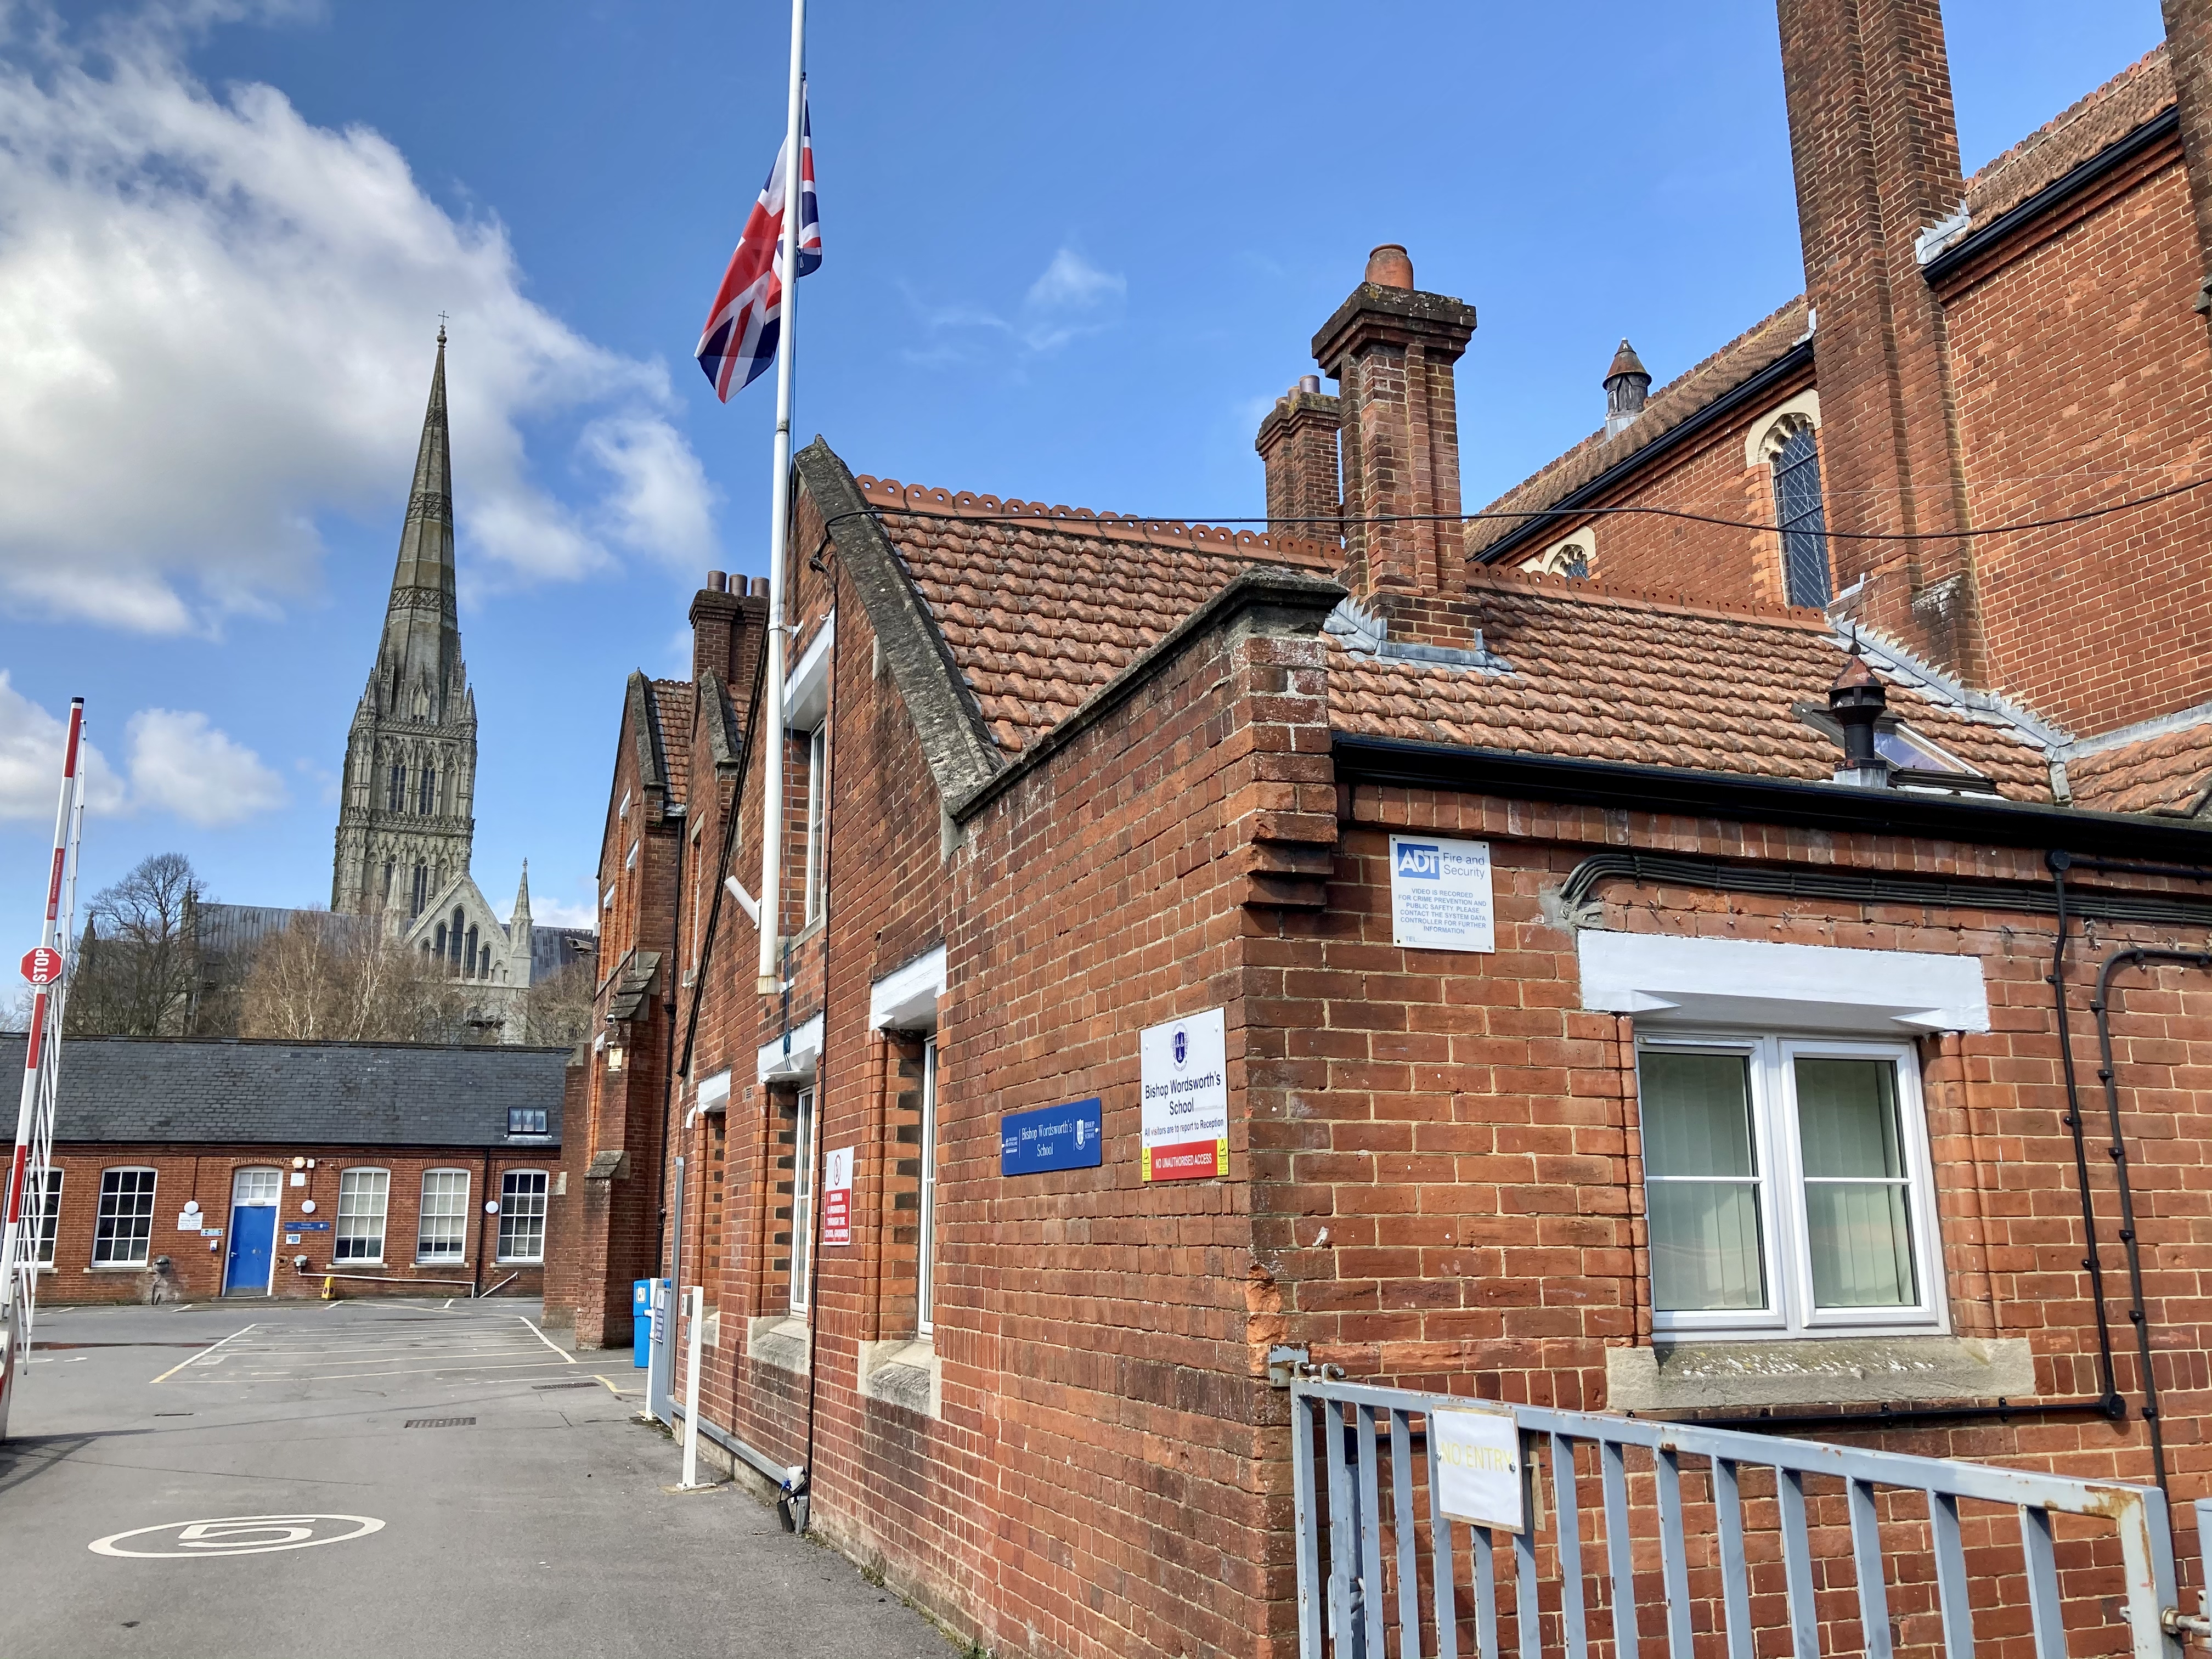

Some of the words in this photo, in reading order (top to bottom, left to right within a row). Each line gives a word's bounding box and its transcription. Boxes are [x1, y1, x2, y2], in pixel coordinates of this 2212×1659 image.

[1398, 849, 1438, 874] ADT
[1443, 852, 1462, 864] Fire
[1466, 856, 1485, 866] and
[1443, 864, 1485, 879] Security
[1439, 890, 1474, 898] RECORDED
[1434, 898, 1472, 906] PREVENTION
[1400, 916, 1443, 926] CONTROLLER
[1444, 912, 1469, 920] SYSTEM
[1423, 925, 1465, 934] INFORMATION
[32, 949, 50, 982] STOP
[1145, 1082, 1169, 1099] Bishop
[1170, 1070, 1221, 1094] Wordsworth's
[1169, 1097, 1194, 1116] School
[1021, 1127, 1037, 1141] Bishop
[1151, 1126, 1166, 1136] visitors
[1180, 1122, 1194, 1134] report
[1194, 1121, 1199, 1130] to
[1200, 1118, 1224, 1131] Reception
[1036, 1142, 1053, 1157] School
[1155, 1158, 1162, 1169] NO
[1162, 1154, 1194, 1169] UNAUTHORISED
[1194, 1152, 1212, 1166] ACCESS
[1441, 1442, 1462, 1466] NO
[1465, 1444, 1513, 1473] ENTRY
[177, 1517, 317, 1548] 5
